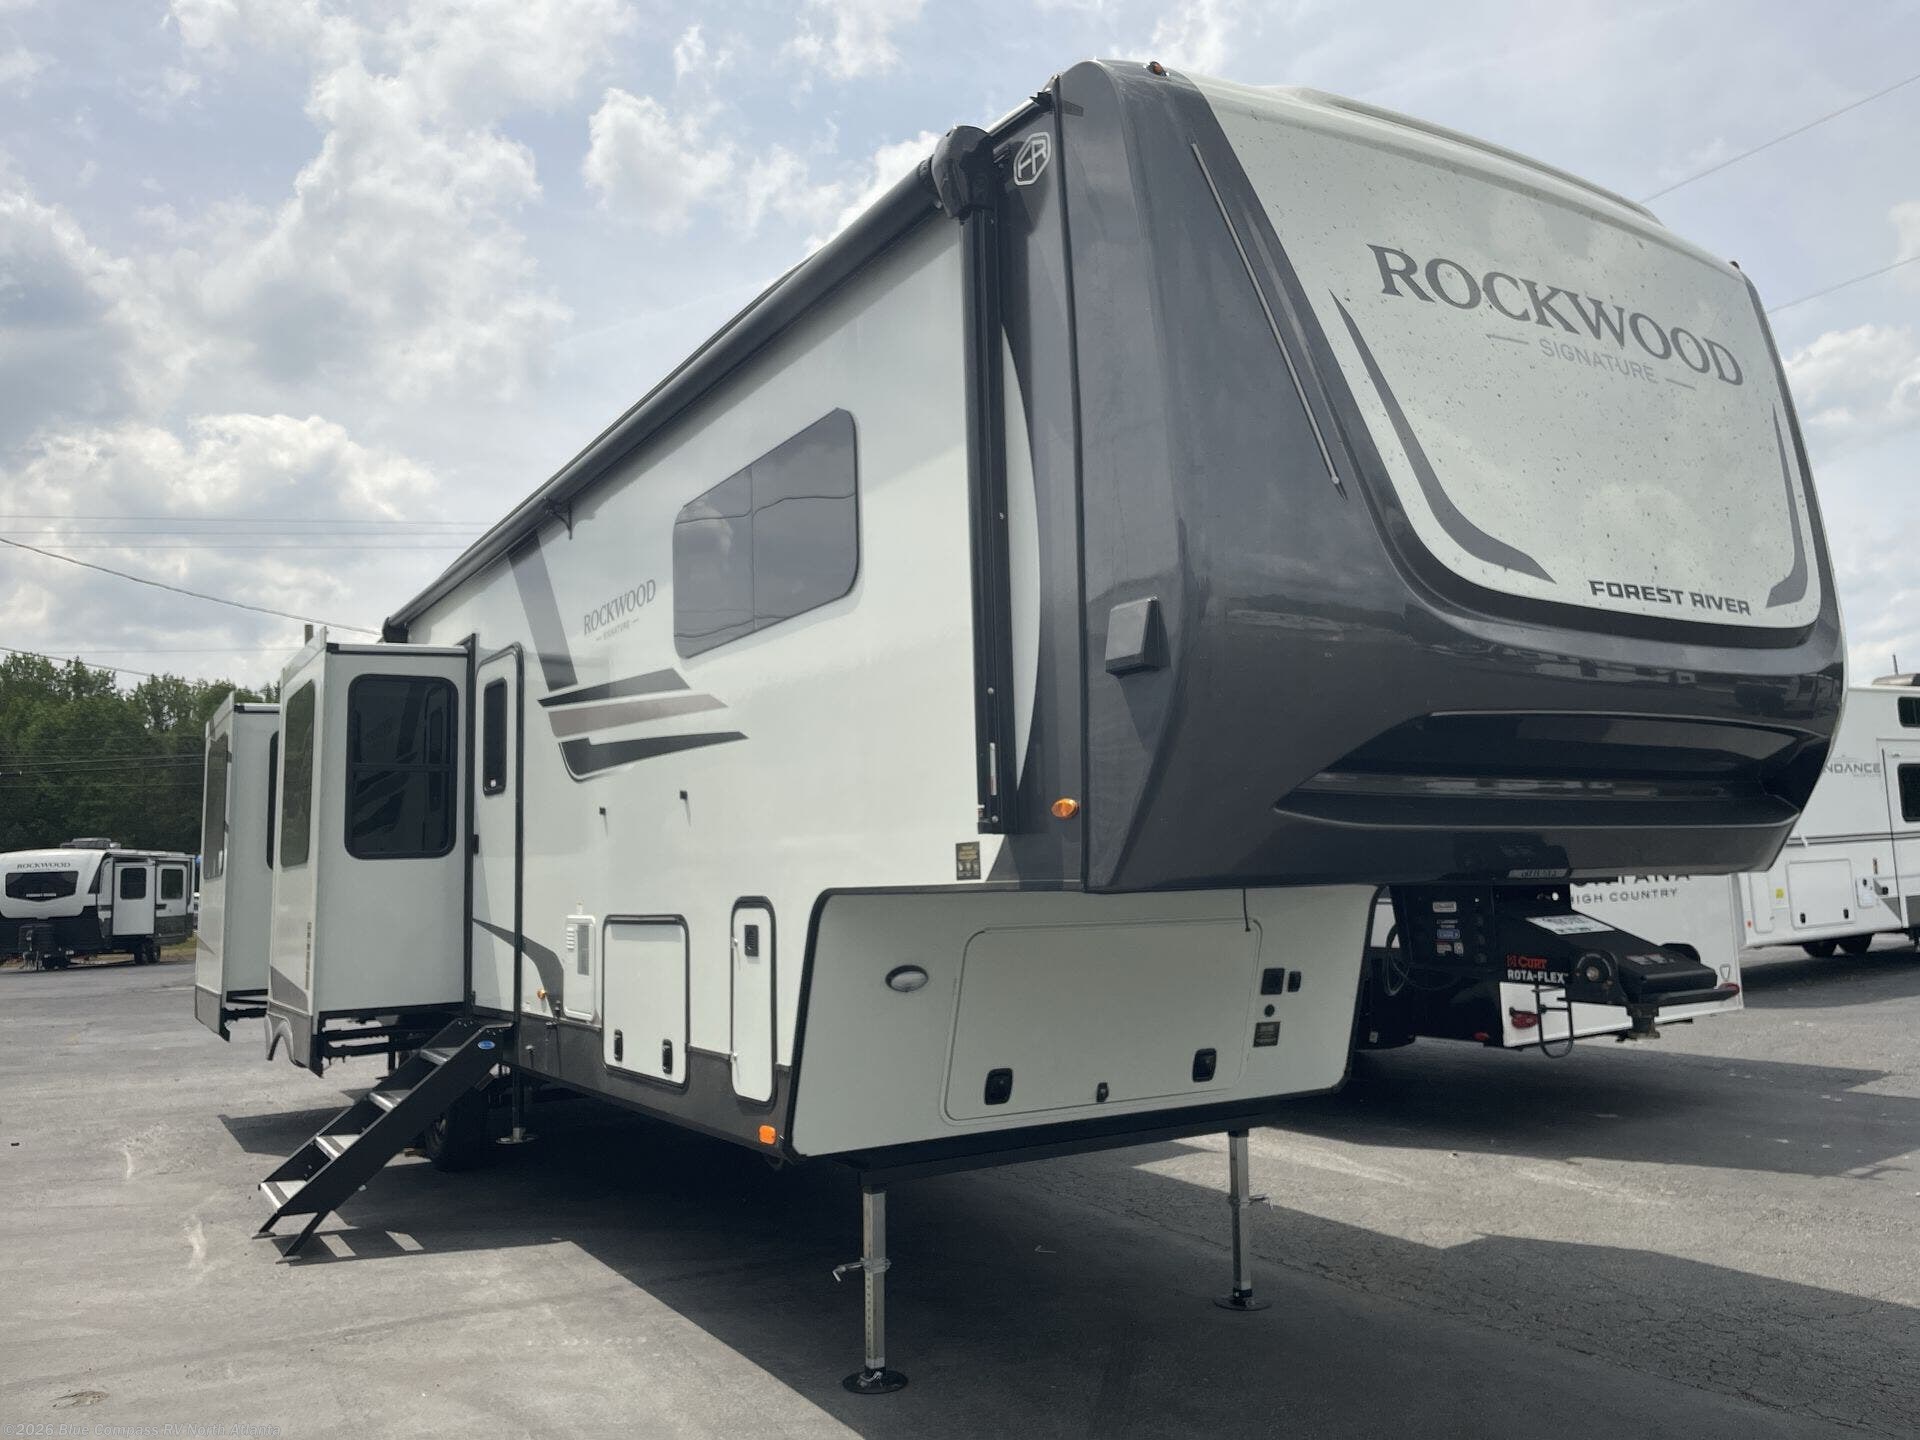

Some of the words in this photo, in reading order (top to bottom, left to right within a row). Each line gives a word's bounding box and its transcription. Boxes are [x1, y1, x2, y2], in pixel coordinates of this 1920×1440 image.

[1366, 243, 1744, 386] ROCKWOOD
[1538, 338, 1659, 385] SIGNATURE
[584, 579, 656, 636] ROCKWOOD
[1588, 580, 1684, 605] FOREST
[1688, 591, 1752, 616] RIVER
[17, 862, 71, 870] ROCKWOOD
[1609, 887, 1677, 903] COUNTRY
[1507, 968, 1566, 985] ROTA-FLEX
